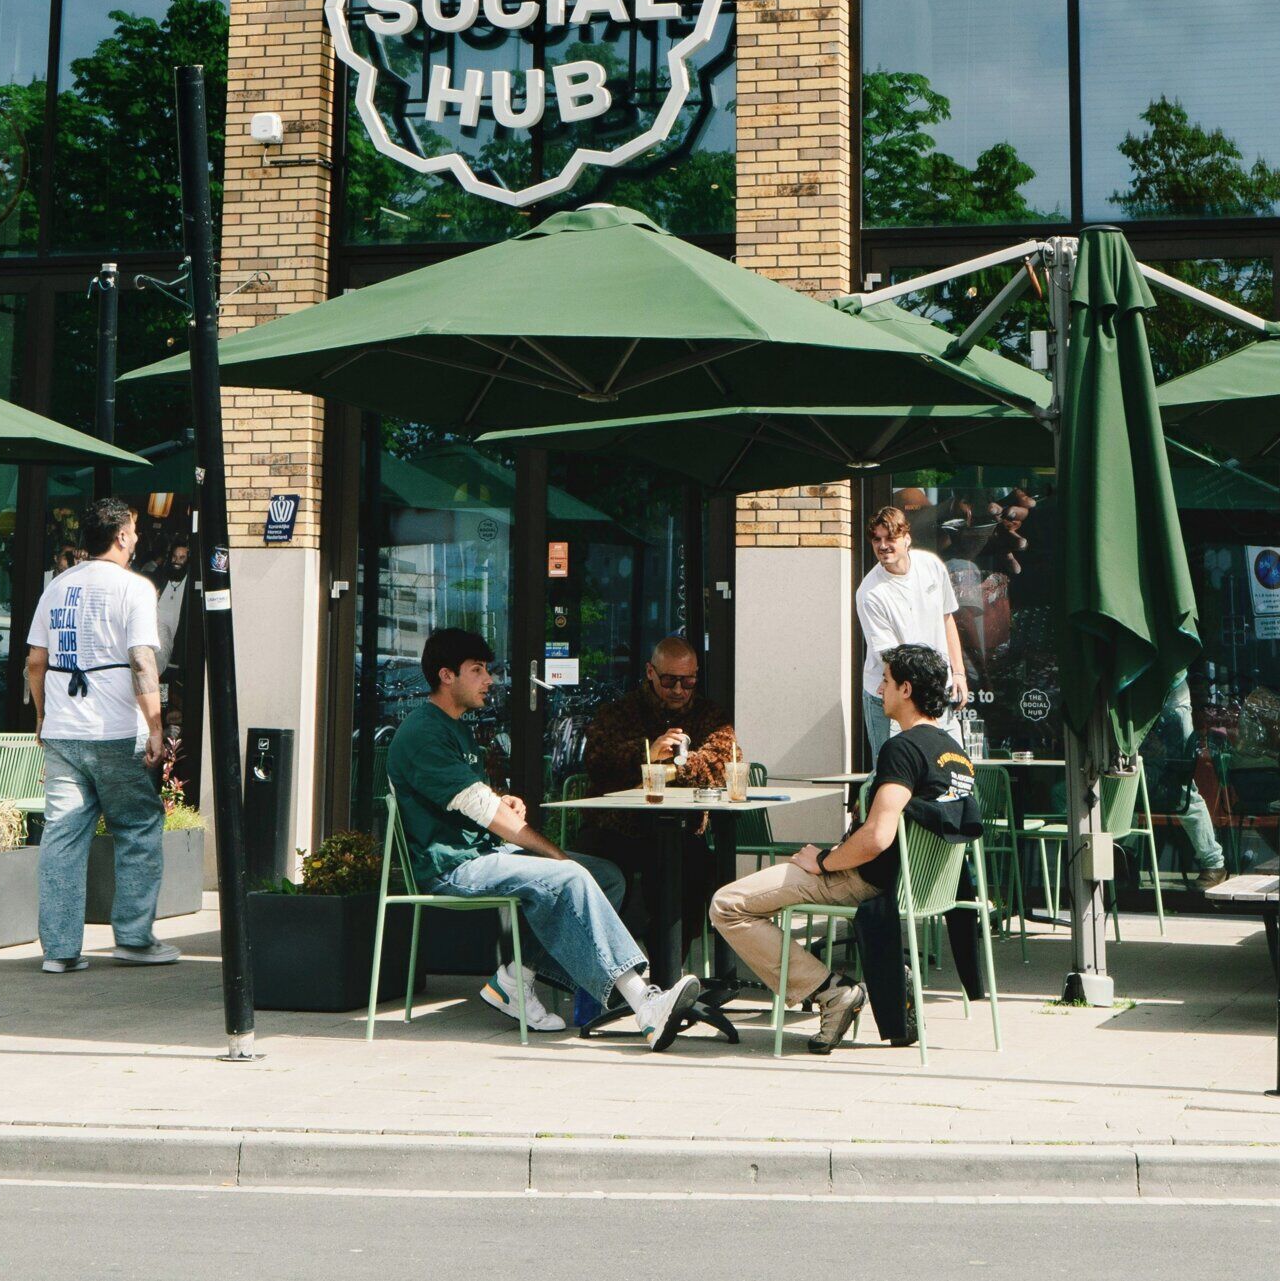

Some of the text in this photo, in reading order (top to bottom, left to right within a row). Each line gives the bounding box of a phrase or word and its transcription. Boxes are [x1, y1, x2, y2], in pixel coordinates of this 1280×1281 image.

[425, 61, 612, 129] HUB
[65, 587, 81, 607] THE
[50, 608, 77, 629] SOCIAL
[58, 631, 77, 652] HUB
[978, 689, 994, 703] to
